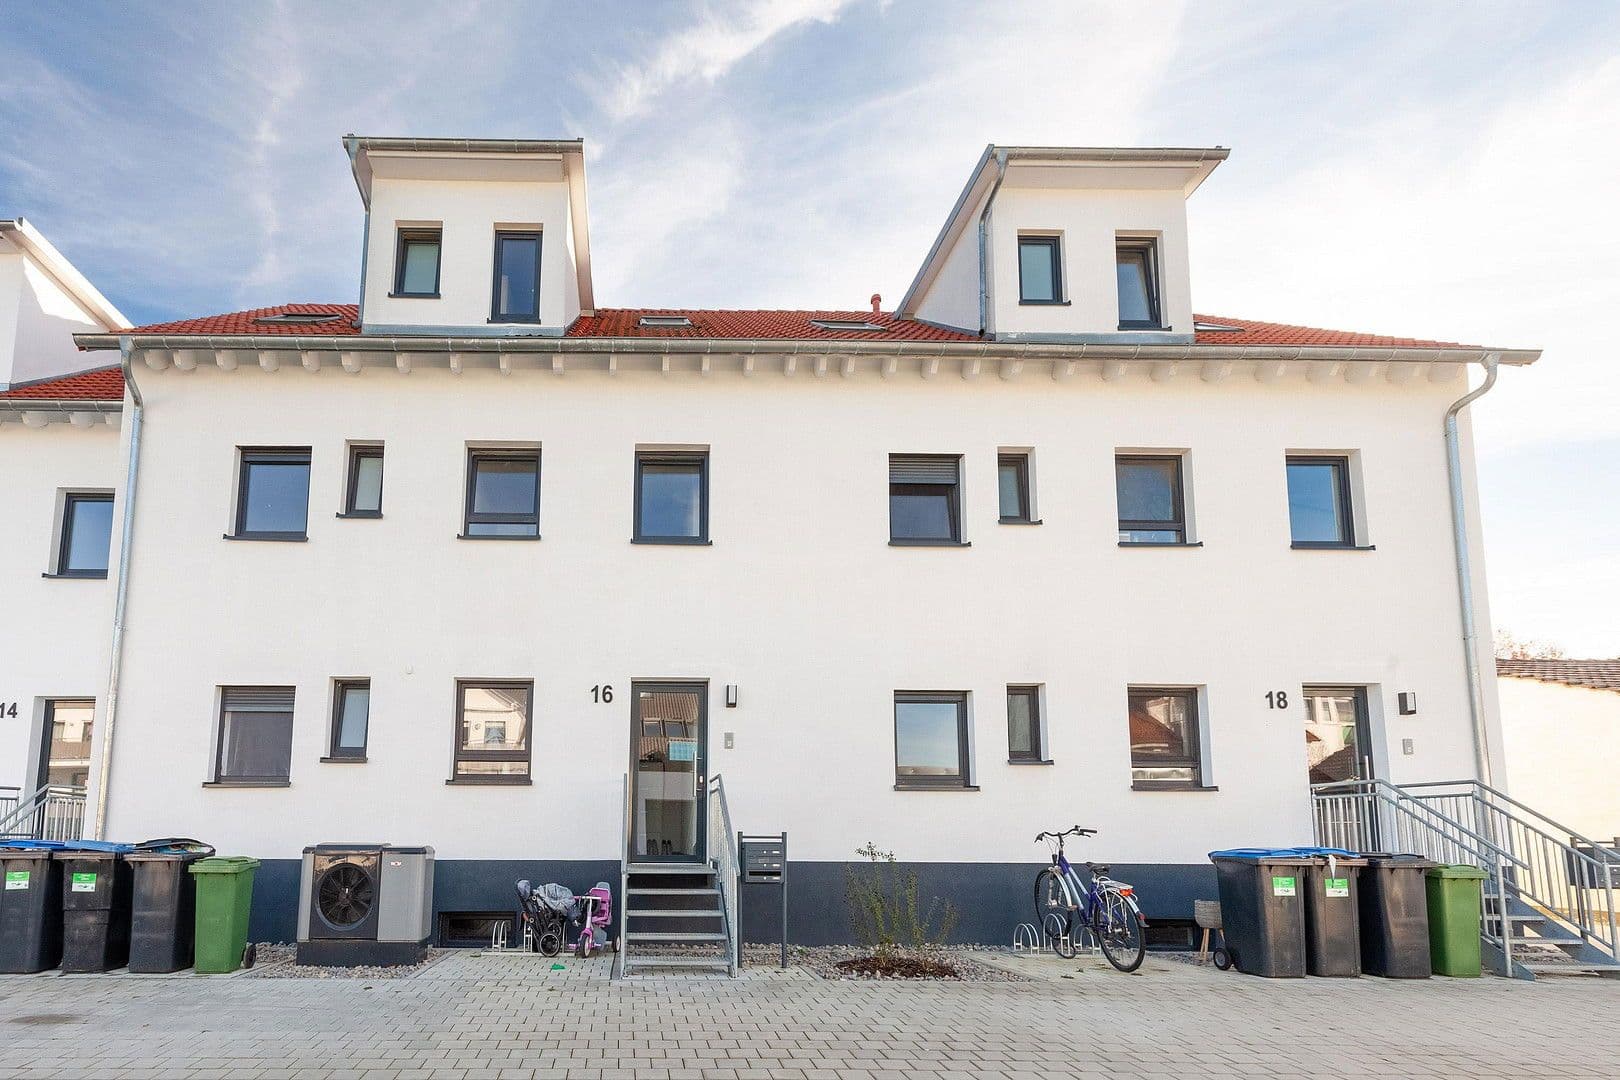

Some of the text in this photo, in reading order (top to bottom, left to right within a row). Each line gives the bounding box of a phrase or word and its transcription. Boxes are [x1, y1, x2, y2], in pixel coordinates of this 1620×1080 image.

[591, 685, 613, 703] 16
[1265, 691, 1288, 709] 18
[0, 702, 17, 718] 14
